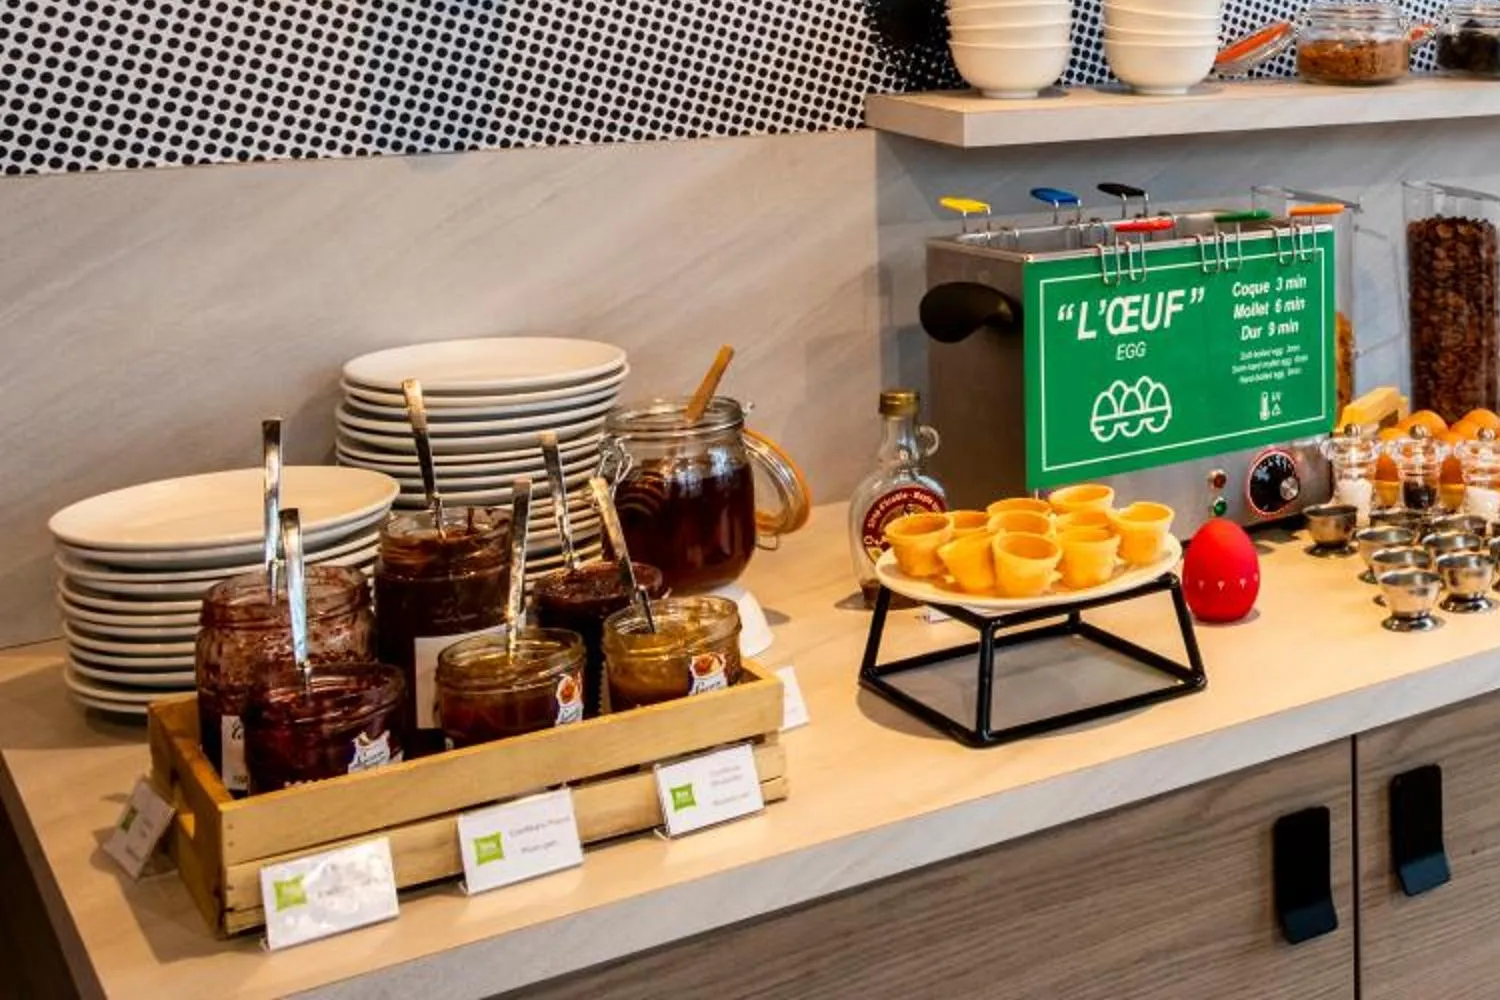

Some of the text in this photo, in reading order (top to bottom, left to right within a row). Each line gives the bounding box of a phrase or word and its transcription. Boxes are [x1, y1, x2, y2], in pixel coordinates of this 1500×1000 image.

[1232, 274, 1307, 298] Coque 3 min
[1233, 296, 1306, 320] Mollet 6 min
[1240, 318, 1299, 341] Dur 9 min
[1115, 341, 1147, 361] EGG
